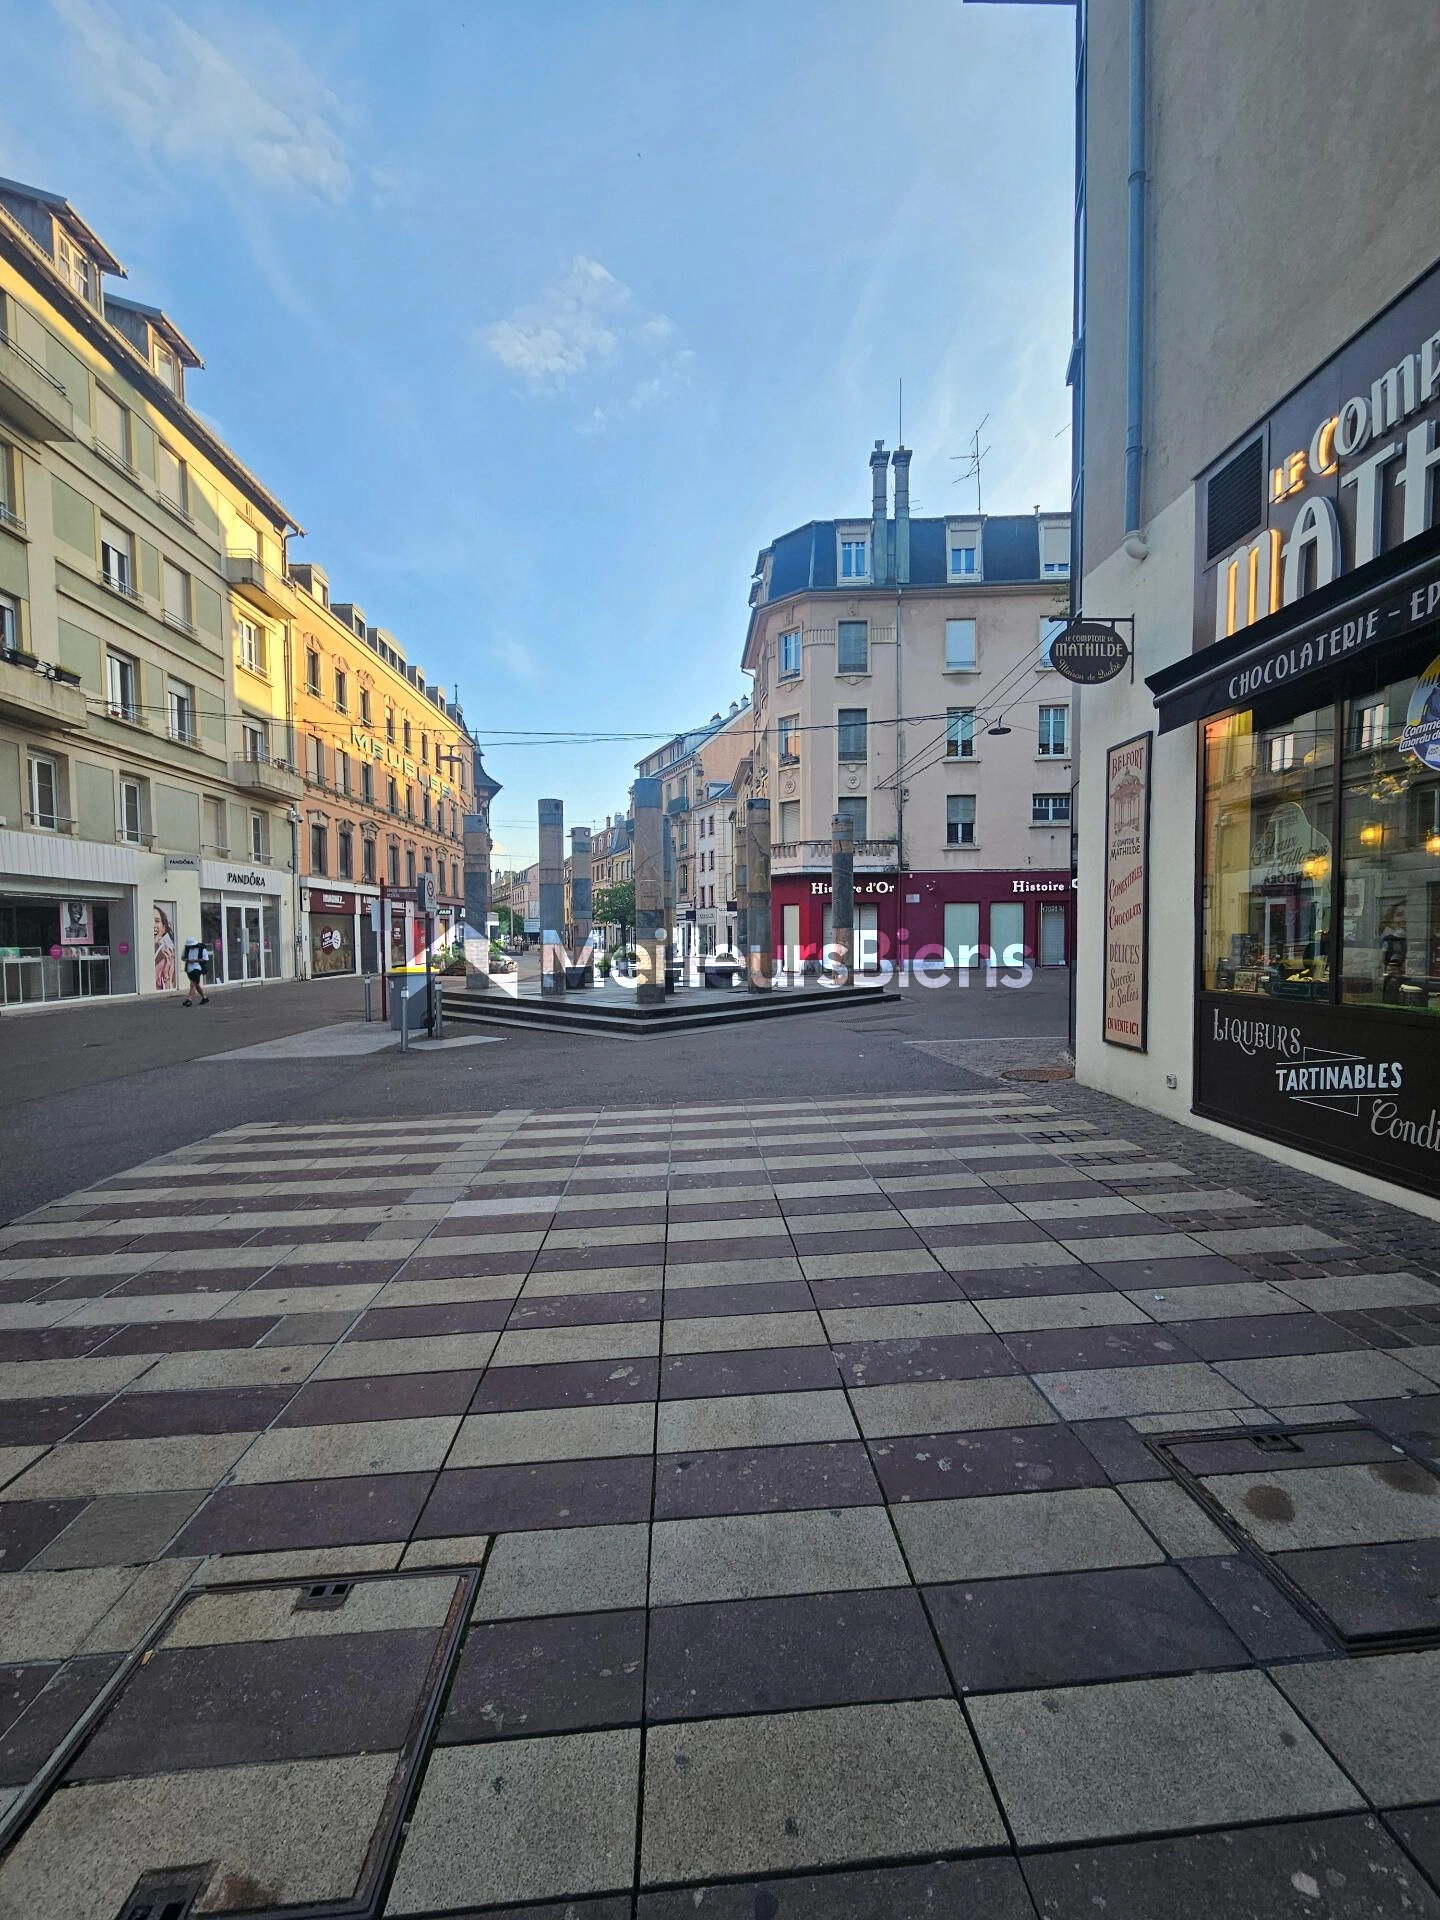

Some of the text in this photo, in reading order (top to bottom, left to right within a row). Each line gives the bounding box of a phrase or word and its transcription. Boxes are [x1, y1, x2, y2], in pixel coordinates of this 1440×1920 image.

[1268, 450, 1306, 505] LE
[1072, 634, 1106, 643] COMPTOIR
[1228, 608, 1380, 700] CHOCOLATERIE
[1409, 580, 1440, 622] EP
[1055, 643, 1123, 657] MATHILDE
[1059, 659, 1084, 680] Maison
[1087, 673, 1096, 681] de
[1401, 733, 1432, 749] mordu
[1111, 747, 1144, 781] BELFORT
[1110, 844, 1141, 861] MATHILDE
[227, 871, 266, 887] PANDORA
[1012, 880, 1065, 893] Histoire
[865, 881, 895, 894] d'Or
[1129, 1021, 1139, 1036] ICI
[1213, 1008, 1301, 1058] LIQUEURS
[1275, 1062, 1403, 1092] TARTINABLES
